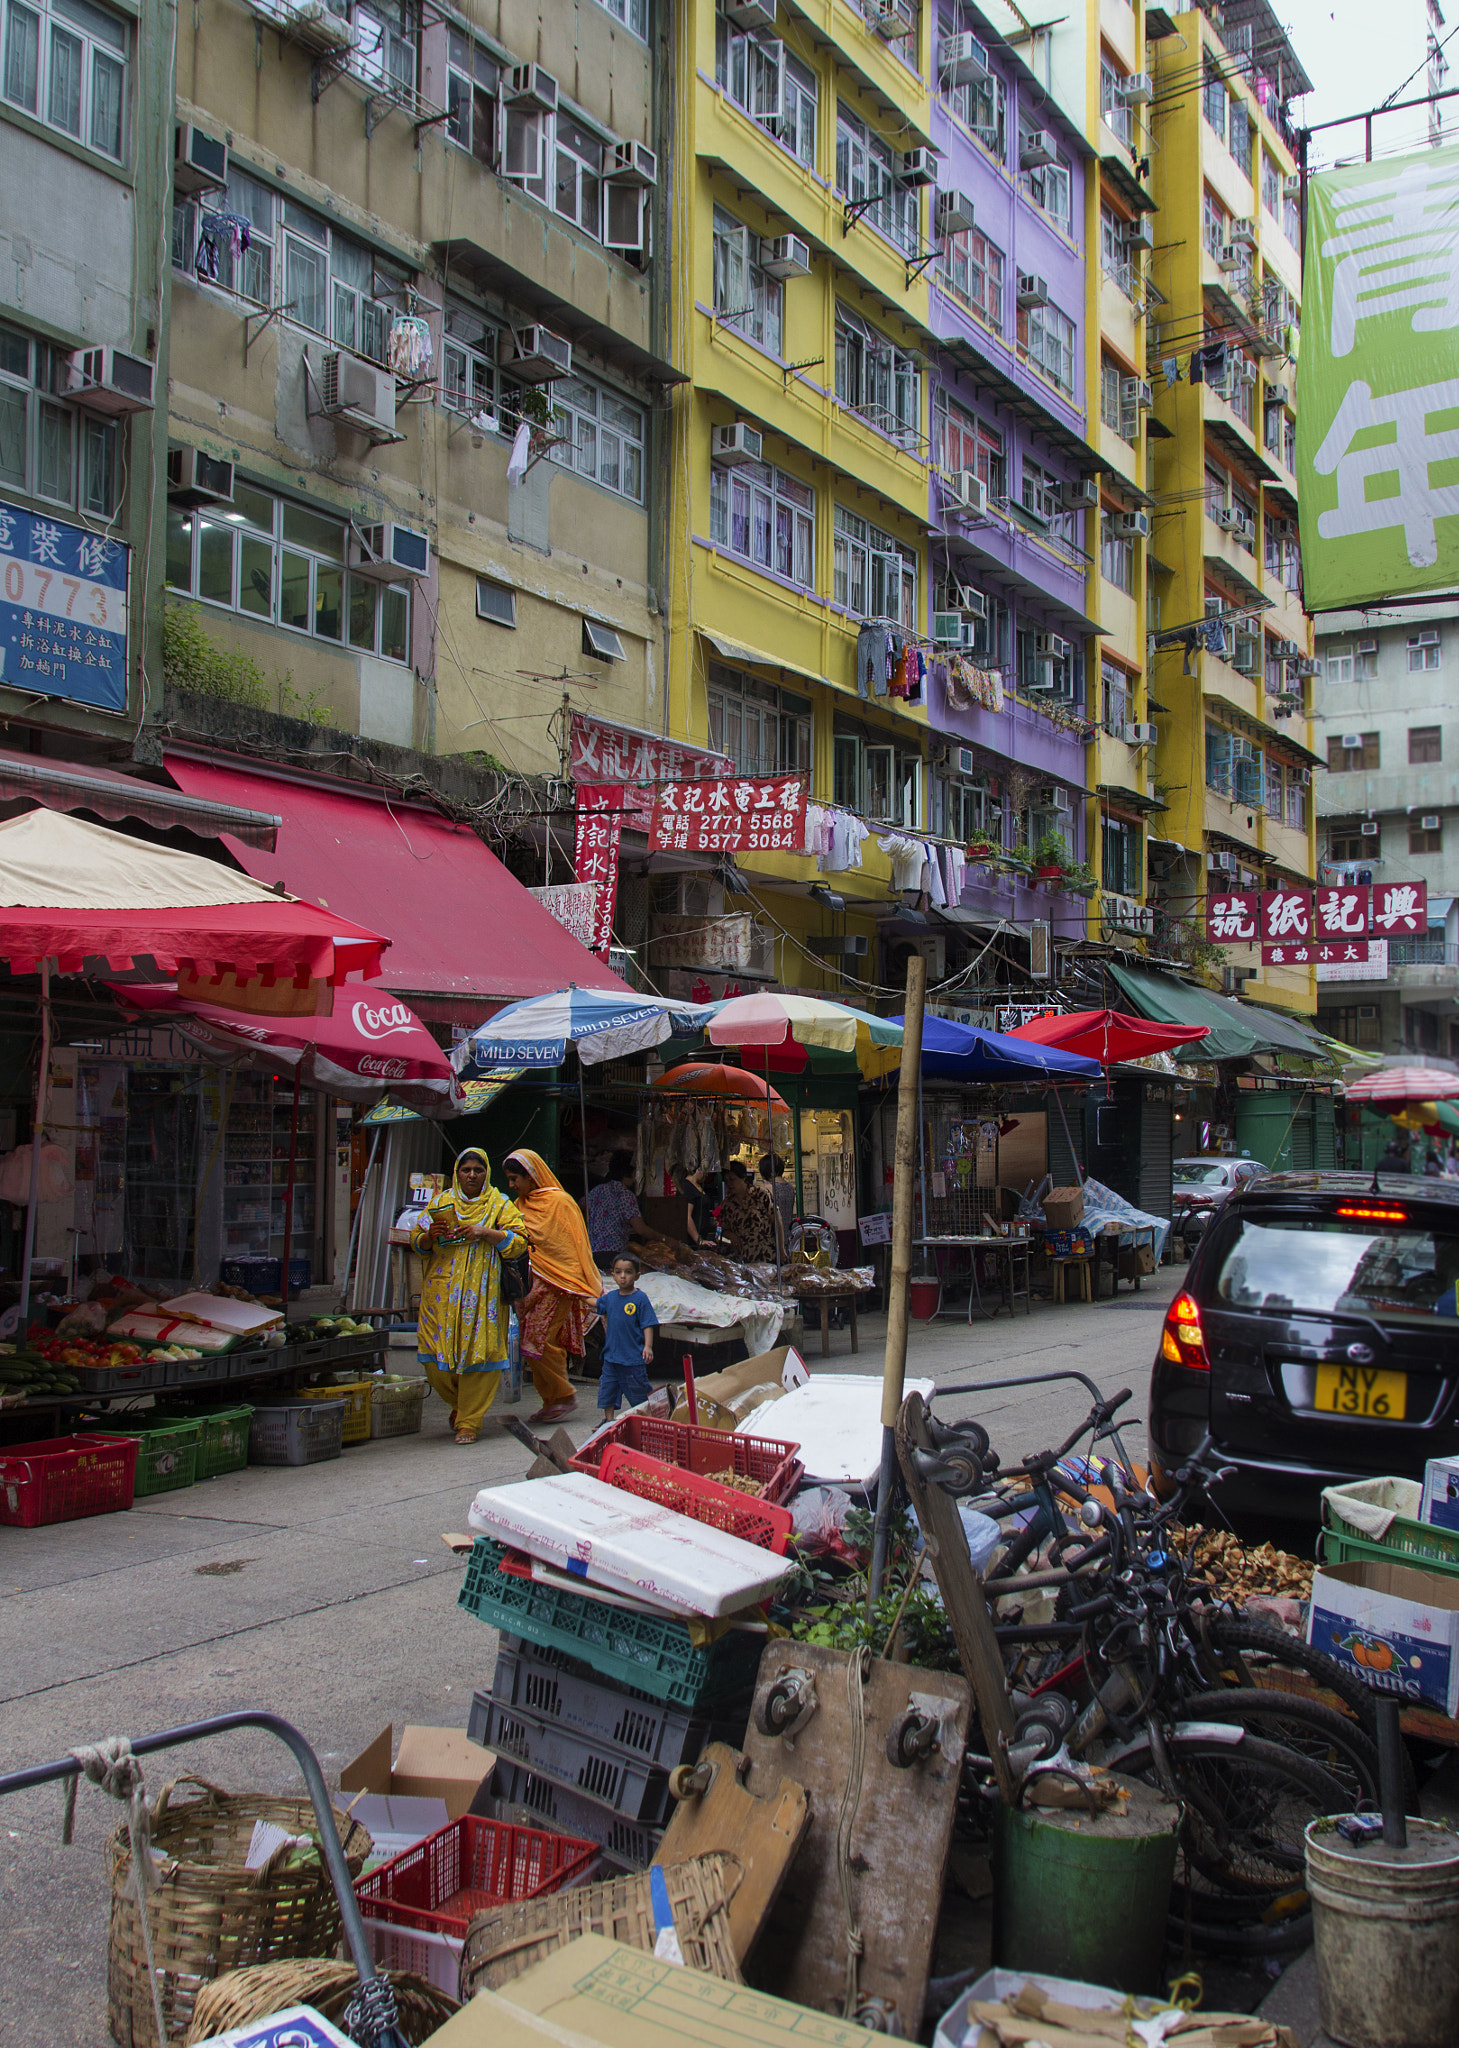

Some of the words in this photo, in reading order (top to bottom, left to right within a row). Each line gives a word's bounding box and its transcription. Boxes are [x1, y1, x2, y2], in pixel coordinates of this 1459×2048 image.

[659, 781, 802, 813] 文記水電工程
[661, 814, 691, 831] 電話
[700, 814, 742, 830] 2771
[749, 813, 794, 830] 5568
[659, 832, 688, 849] 手提
[698, 833, 742, 849] 9377
[748, 832, 793, 848] 3084
[573, 1020, 610, 1034] MILD
[612, 1006, 660, 1027] SEVEN
[480, 1045, 515, 1060] MILD
[517, 1045, 560, 1060] SEVEN
[1339, 1366, 1378, 1391] NV
[1332, 1386, 1391, 1416] 1316
